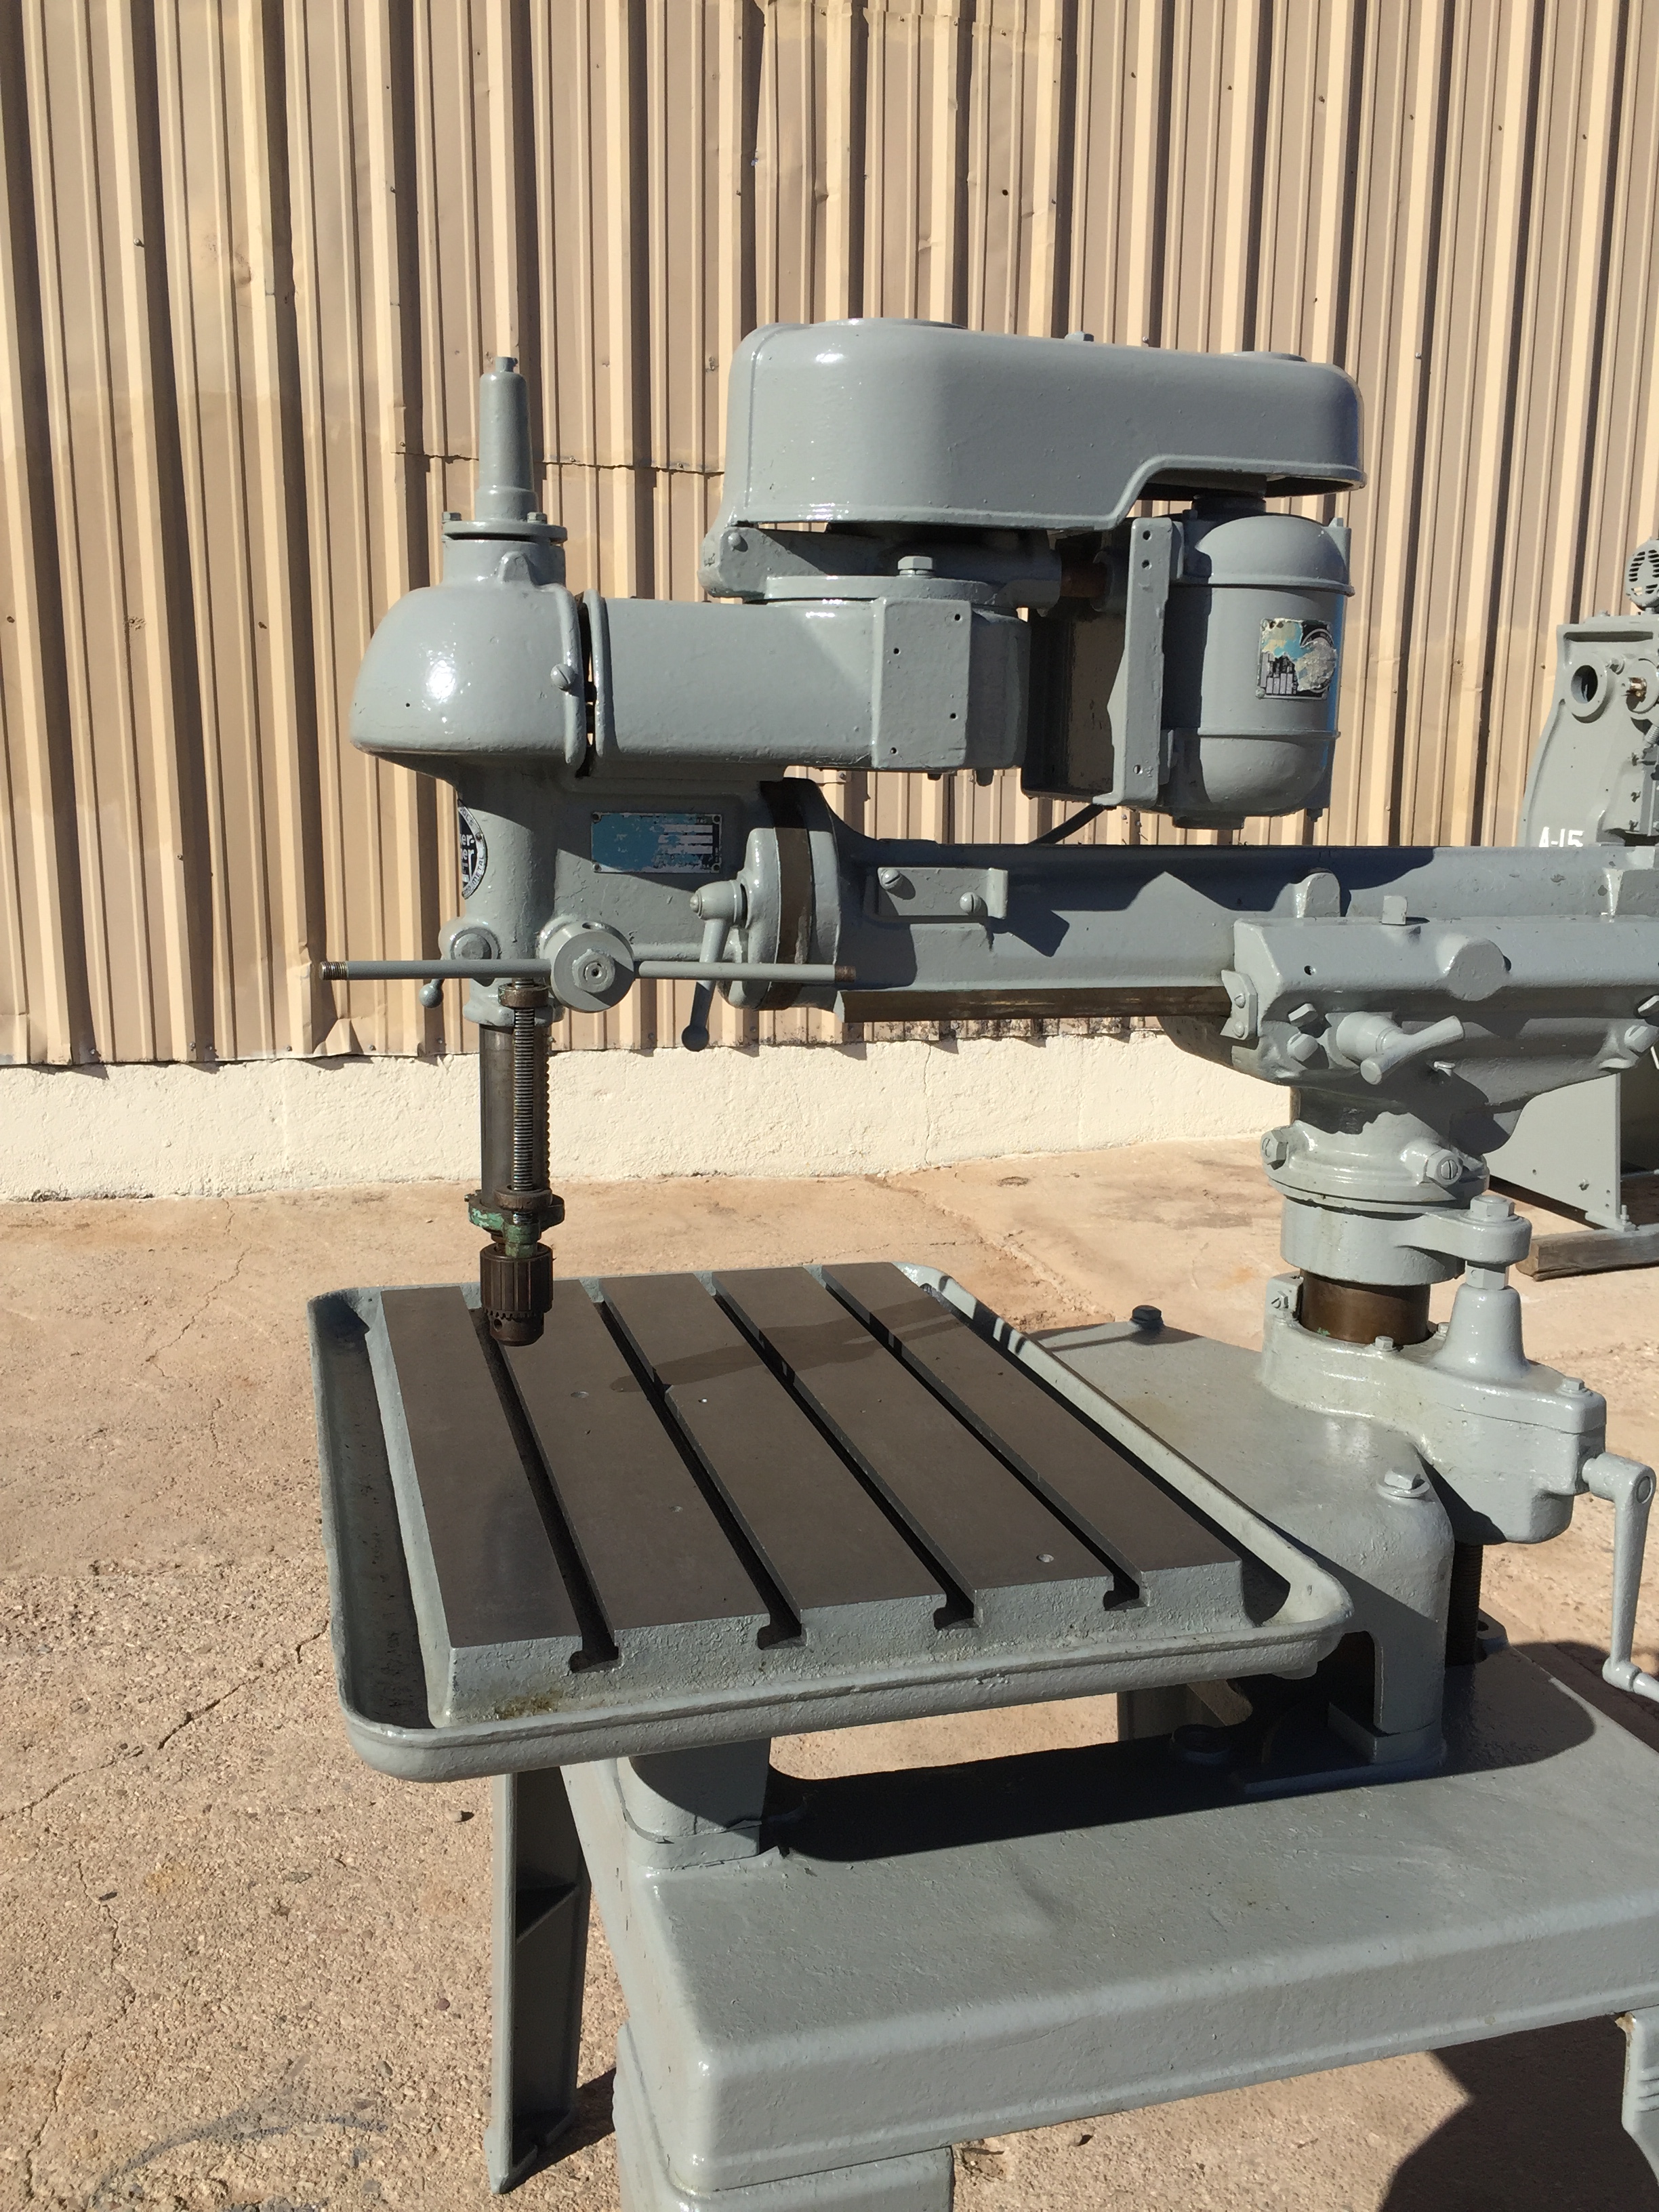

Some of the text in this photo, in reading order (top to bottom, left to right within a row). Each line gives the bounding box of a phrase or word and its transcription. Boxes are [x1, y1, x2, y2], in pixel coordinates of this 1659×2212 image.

[460, 834, 475, 846] er-
[1538, 826, 1584, 847] A-15
[472, 857, 485, 886] METAL
